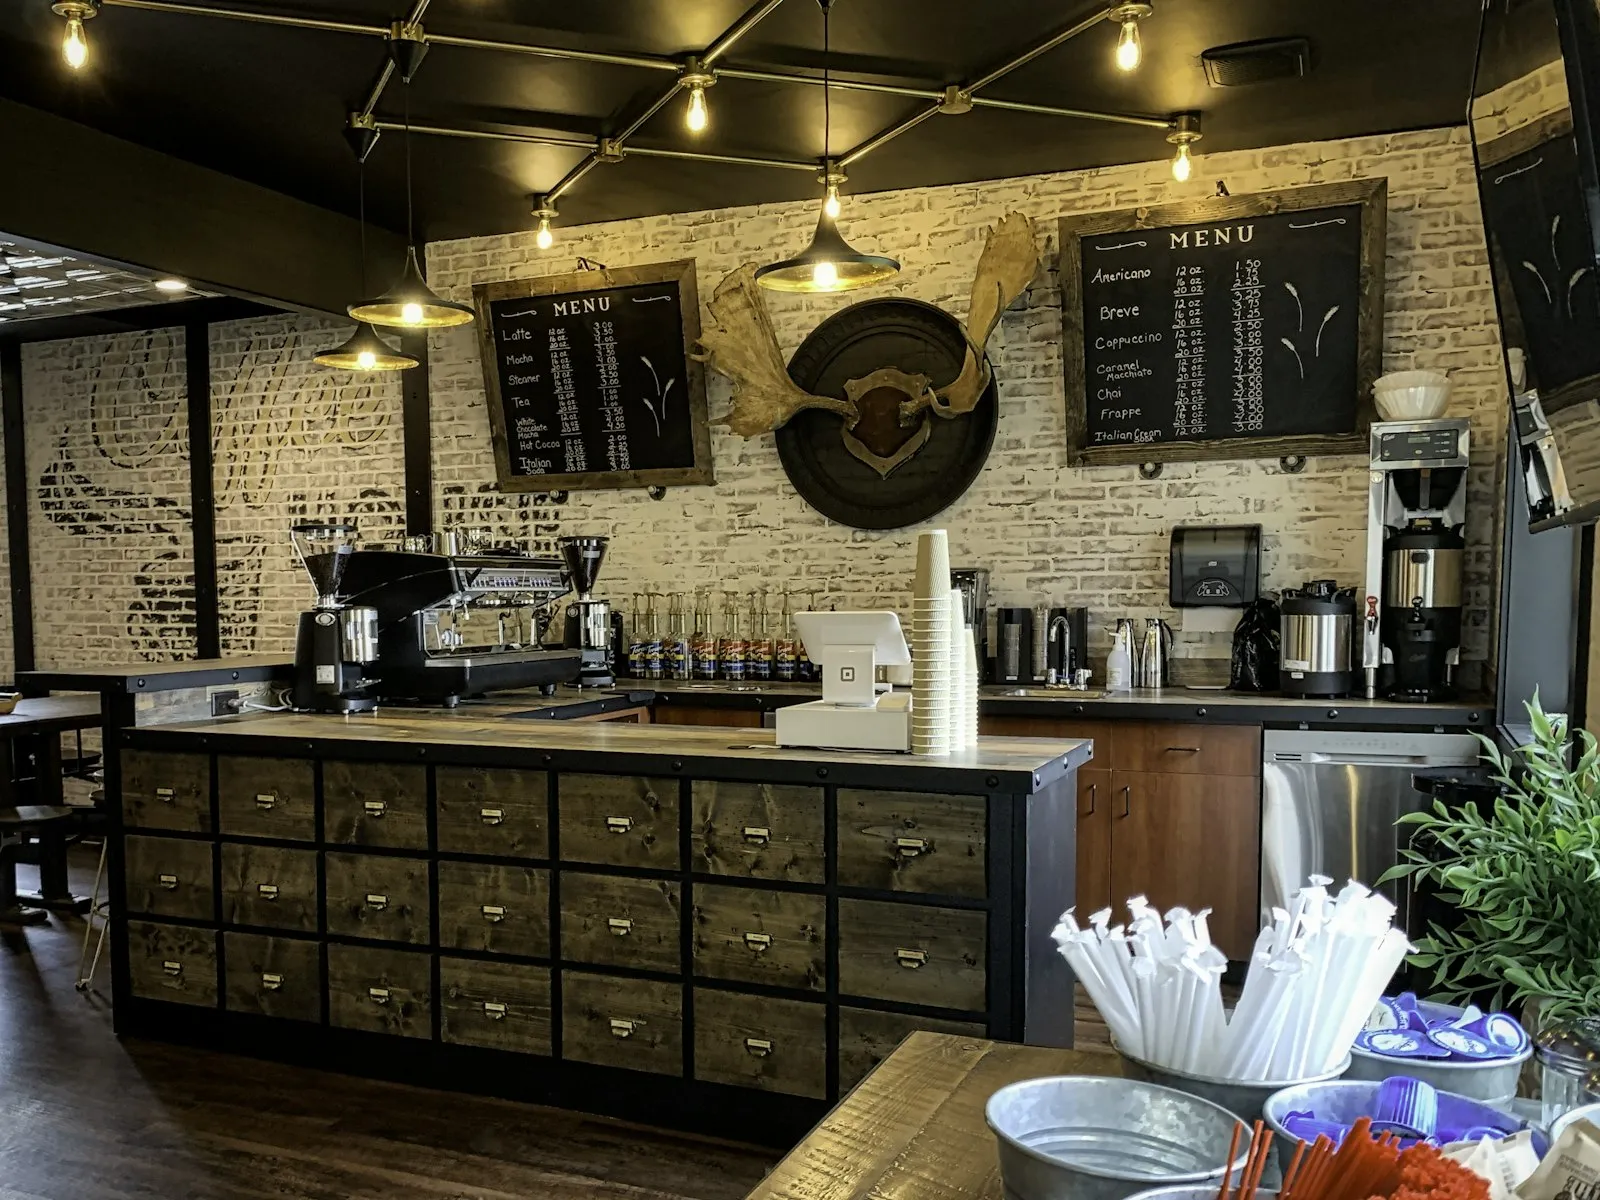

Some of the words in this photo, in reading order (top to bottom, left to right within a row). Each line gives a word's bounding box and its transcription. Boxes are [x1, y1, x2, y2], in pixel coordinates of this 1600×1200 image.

[1169, 225, 1254, 249] MENU
[1176, 266, 1186, 276] 12
[1236, 259, 1261, 270] 1.50
[1091, 268, 1151, 284] Americano
[1176, 278, 1185, 286] 16
[1236, 268, 1258, 278] 1.75
[1174, 286, 1187, 294] 20
[1232, 277, 1259, 288] 2.25
[1175, 299, 1186, 309] 12
[1232, 289, 1261, 302] 3.25
[553, 297, 610, 316] MENU
[1100, 305, 1140, 320] Breve
[1175, 310, 1184, 320] 16
[1232, 300, 1259, 311] 3.75
[1172, 320, 1186, 328] 20
[1234, 308, 1260, 320] 4.25
[593, 322, 613, 330] 3.00
[594, 328, 614, 336] 3.50
[1175, 330, 1188, 339] 12
[1234, 321, 1262, 332] 2.50
[502, 328, 532, 342] Latte
[595, 336, 614, 344] 4.00
[1095, 332, 1162, 350] Cappuccino
[1177, 340, 1186, 348] 16
[1234, 330, 1262, 340] 3.00
[1175, 349, 1189, 358] 20
[1234, 338, 1261, 348] 3.50
[506, 354, 534, 366] Mocha
[1178, 358, 1188, 366] 12
[1234, 348, 1263, 358] 3.50
[1096, 360, 1139, 374] Caramel
[1178, 366, 1187, 374] 16
[1234, 357, 1262, 367] 4.00
[508, 374, 540, 386] Steamer
[554, 372, 560, 380] 12
[1106, 368, 1152, 381] Macchiato
[1176, 374, 1189, 382] 20
[1234, 364, 1262, 375] 4.50
[600, 378, 619, 386] 3.00
[1178, 382, 1188, 390] 12
[1235, 376, 1262, 384] 3.00
[1098, 386, 1122, 400] Chai
[1174, 397, 1189, 406] 20
[1234, 390, 1262, 398] 4.00
[1177, 390, 1186, 400] 16
[1234, 382, 1262, 392] 3.50
[511, 396, 530, 408] Tea
[1236, 398, 1263, 406] 3.00
[604, 408, 624, 417] 3.50
[1100, 408, 1142, 420] Frappe
[1176, 412, 1185, 420] 16
[1234, 405, 1264, 414] 3.50
[1234, 413, 1263, 422] 4.00
[515, 418, 536, 426] White
[516, 424, 548, 432] Chocolate
[1176, 428, 1188, 436] 12
[1235, 422, 1262, 432] 3.00
[518, 432, 540, 440] Mocha
[1094, 430, 1133, 442] Italian
[1134, 428, 1162, 438] Cream
[520, 440, 533, 451] Hot
[535, 440, 560, 450] Cocoa
[518, 457, 552, 469] Italian
[526, 468, 546, 476] Soda
